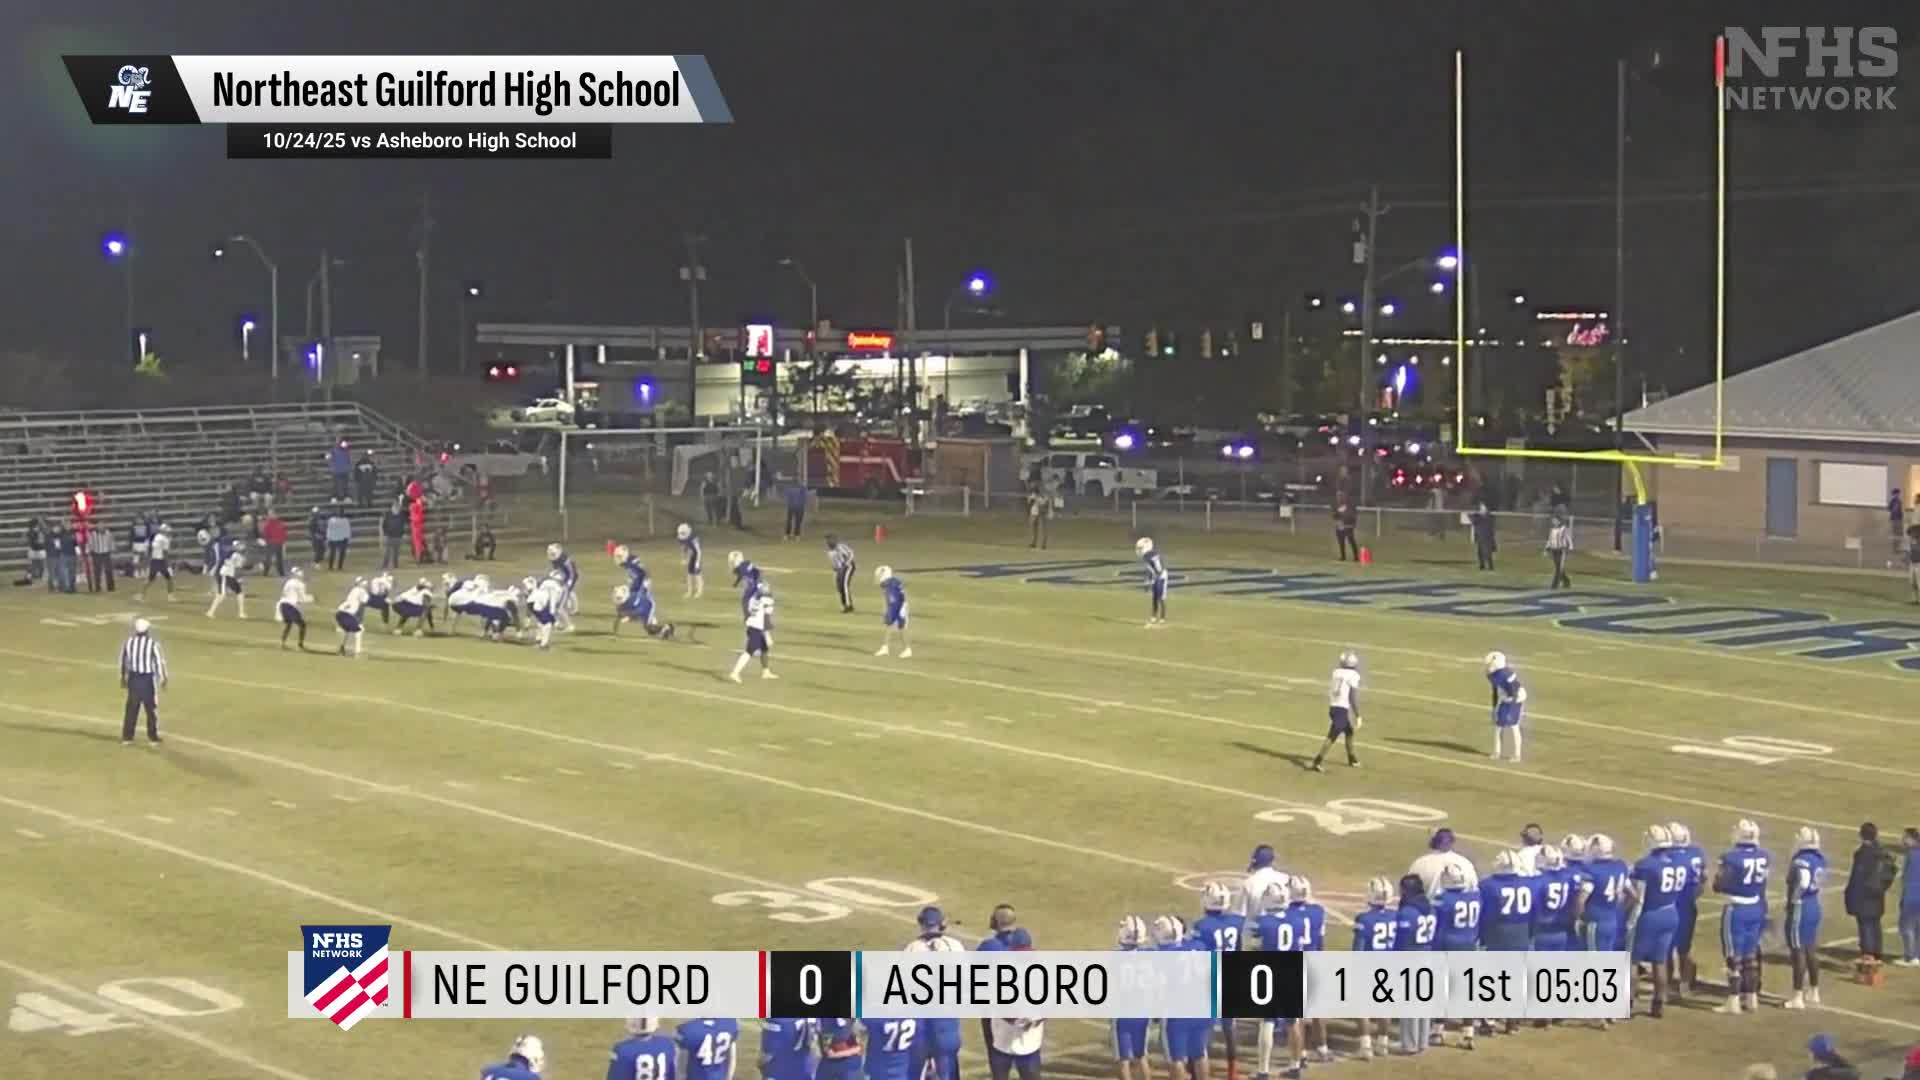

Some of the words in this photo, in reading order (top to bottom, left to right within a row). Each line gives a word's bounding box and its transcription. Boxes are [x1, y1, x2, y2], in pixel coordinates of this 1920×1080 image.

[1672, 735, 1834, 766] 10
[1253, 797, 1449, 836] 20
[1660, 864, 1688, 893] 68
[1742, 856, 1768, 885] 75
[711, 876, 940, 924] 30
[1453, 900, 1480, 929] 20
[1500, 885, 1532, 915] 70
[1214, 926, 1238, 951] 13
[1415, 914, 1438, 944] 23
[8, 977, 245, 1037] 40
[697, 1032, 731, 1065] 42
[882, 1018, 917, 1051] 72
[636, 1052, 666, 1080] 81
